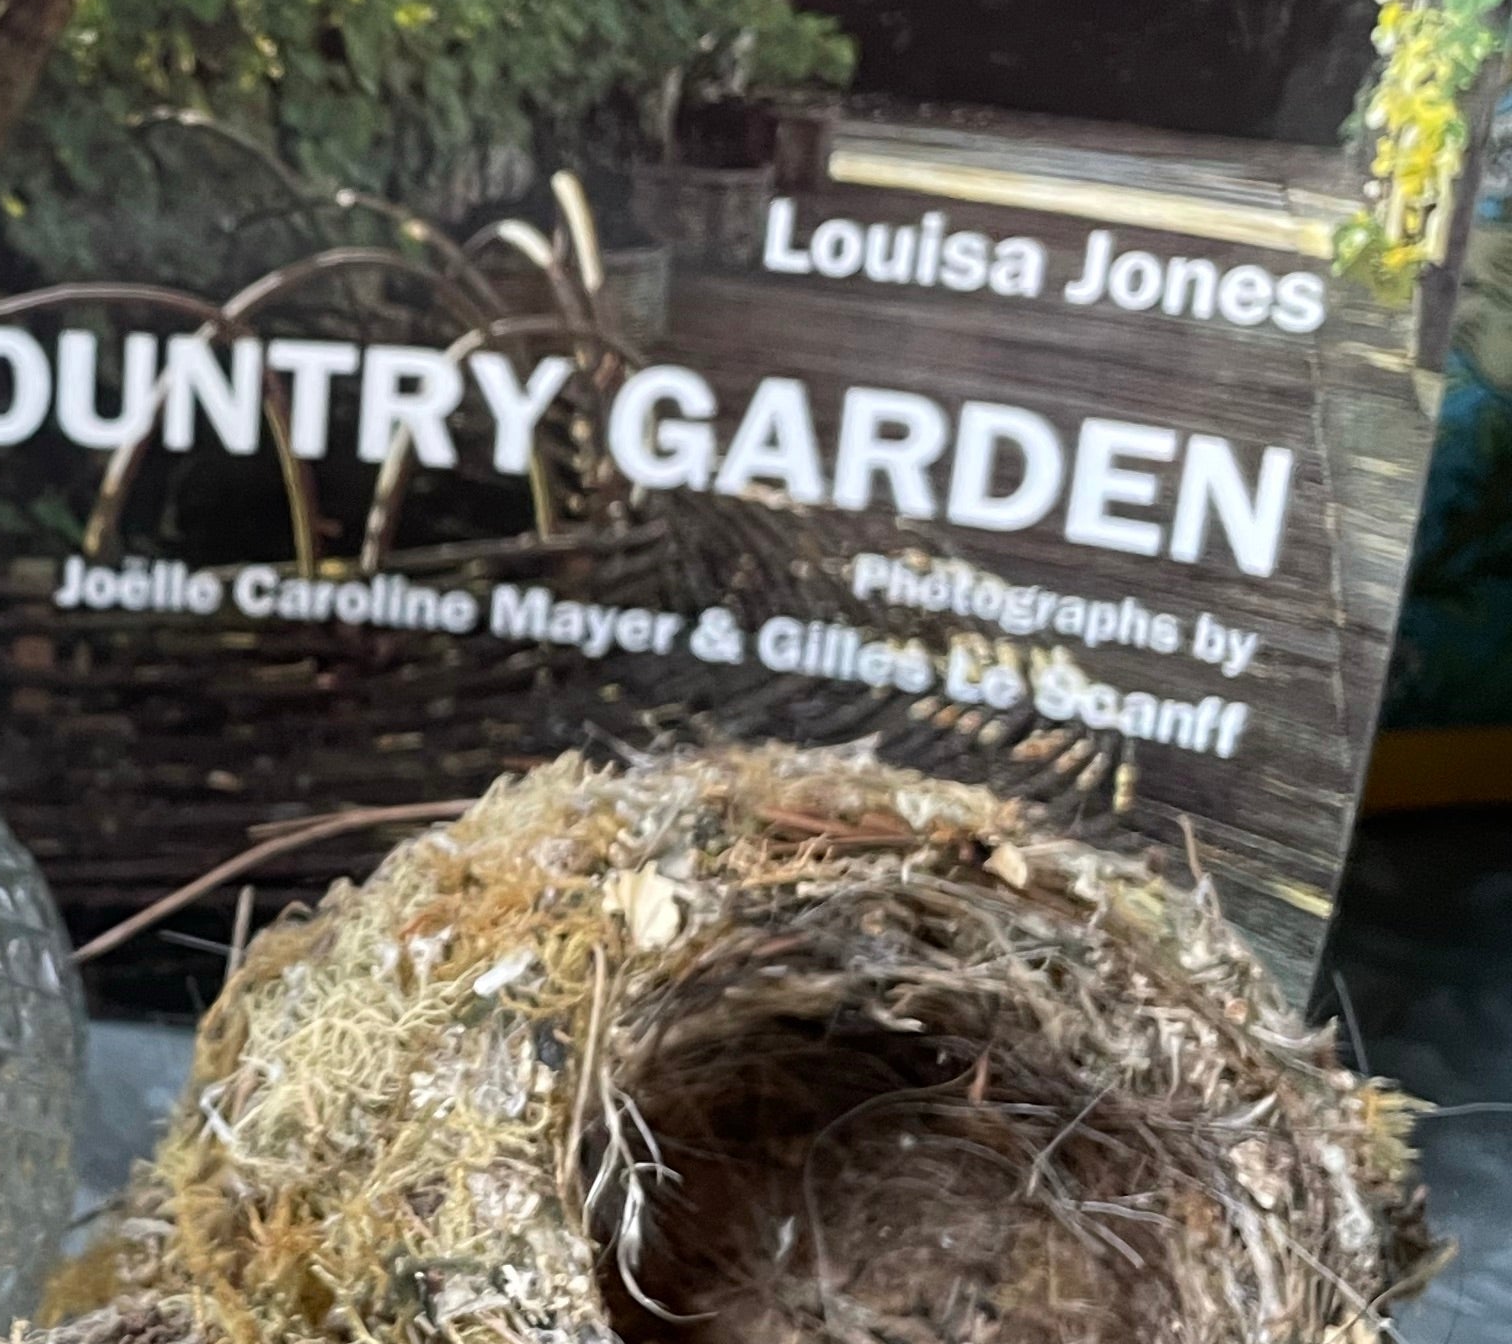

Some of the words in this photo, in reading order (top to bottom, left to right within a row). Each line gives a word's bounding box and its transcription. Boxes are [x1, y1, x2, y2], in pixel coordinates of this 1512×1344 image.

[763, 197, 1047, 299] Louisa
[1065, 229, 1326, 333] Jones
[607, 364, 1294, 578] GARDEN
[54, 555, 221, 613] Joëlle
[234, 568, 479, 635] Caroline
[489, 584, 685, 659] Mayer
[689, 607, 745, 665] &
[757, 615, 935, 695] Gilles
[946, 640, 1027, 710] Le
[1032, 646, 1250, 760] Scanff
[853, 552, 1184, 655] Photographs
[1193, 612, 1260, 679] by
